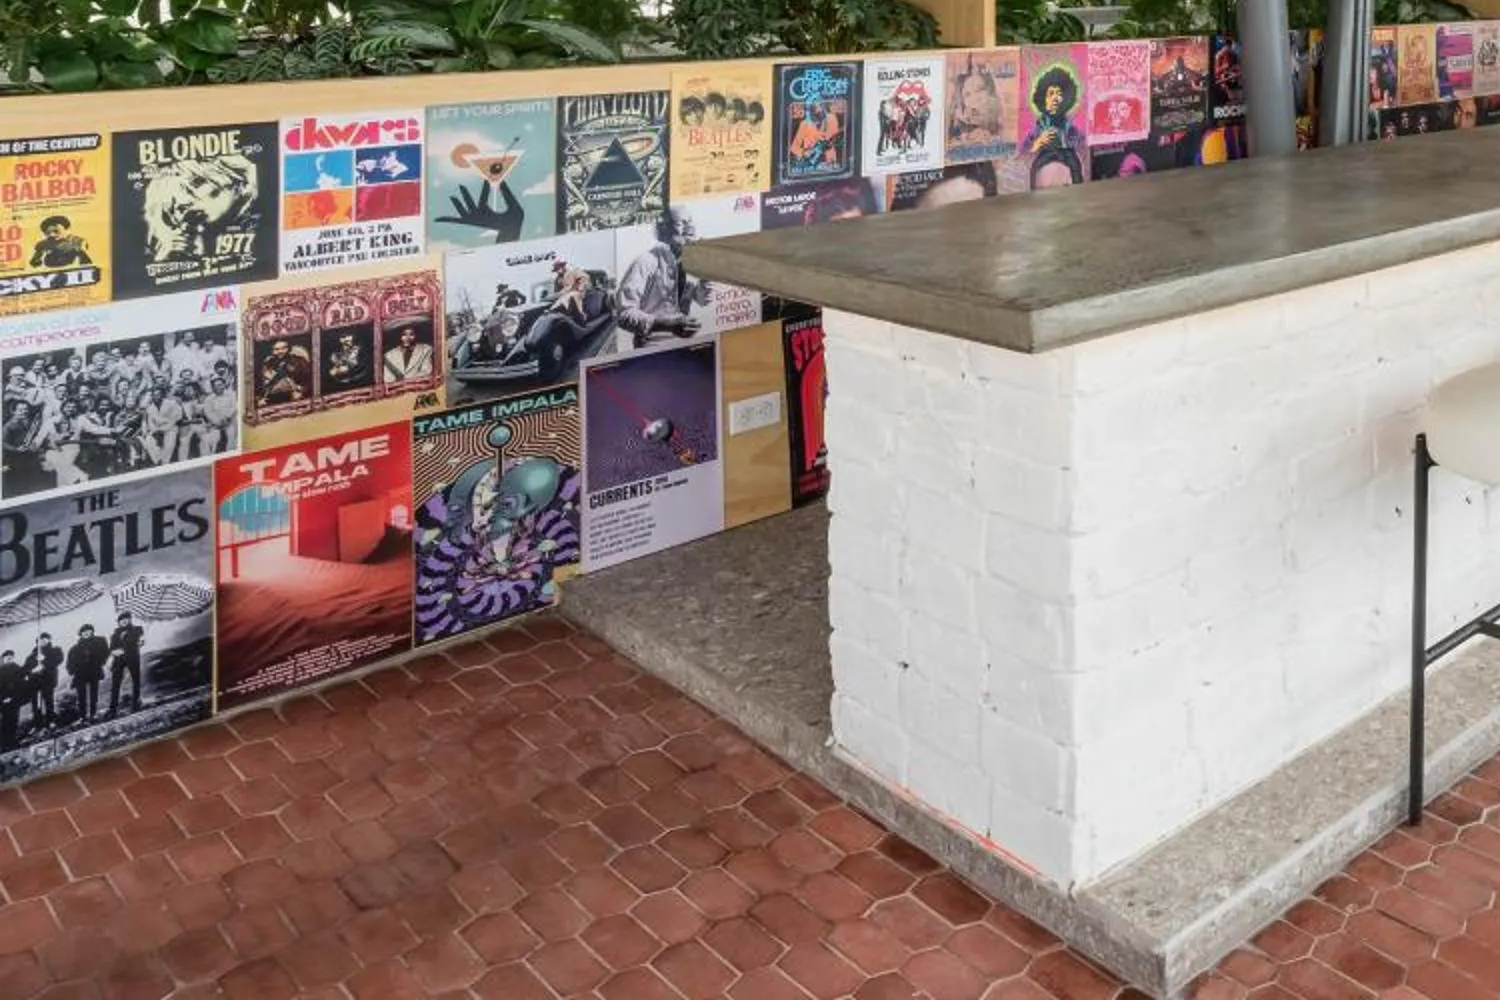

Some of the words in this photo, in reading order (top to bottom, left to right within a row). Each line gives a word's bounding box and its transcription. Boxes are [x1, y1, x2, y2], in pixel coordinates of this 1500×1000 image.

[12, 141, 28, 154] OF
[49, 135, 98, 150] CENTURY
[139, 129, 241, 165] BLONDIE
[687, 127, 752, 147] BEATLES
[15, 159, 84, 180] ROCKY
[1, 176, 96, 202] BALBOA
[215, 233, 256, 255] 1977
[293, 238, 364, 258] ALBERT
[369, 232, 413, 248] KING
[284, 255, 345, 270] VANCOUVER
[415, 409, 484, 433] TAME
[491, 389, 578, 417] IMPALA
[239, 434, 391, 484] TAME
[73, 489, 122, 516] THE
[589, 480, 653, 510] CURRENTS
[0, 497, 210, 587] BEATLES
